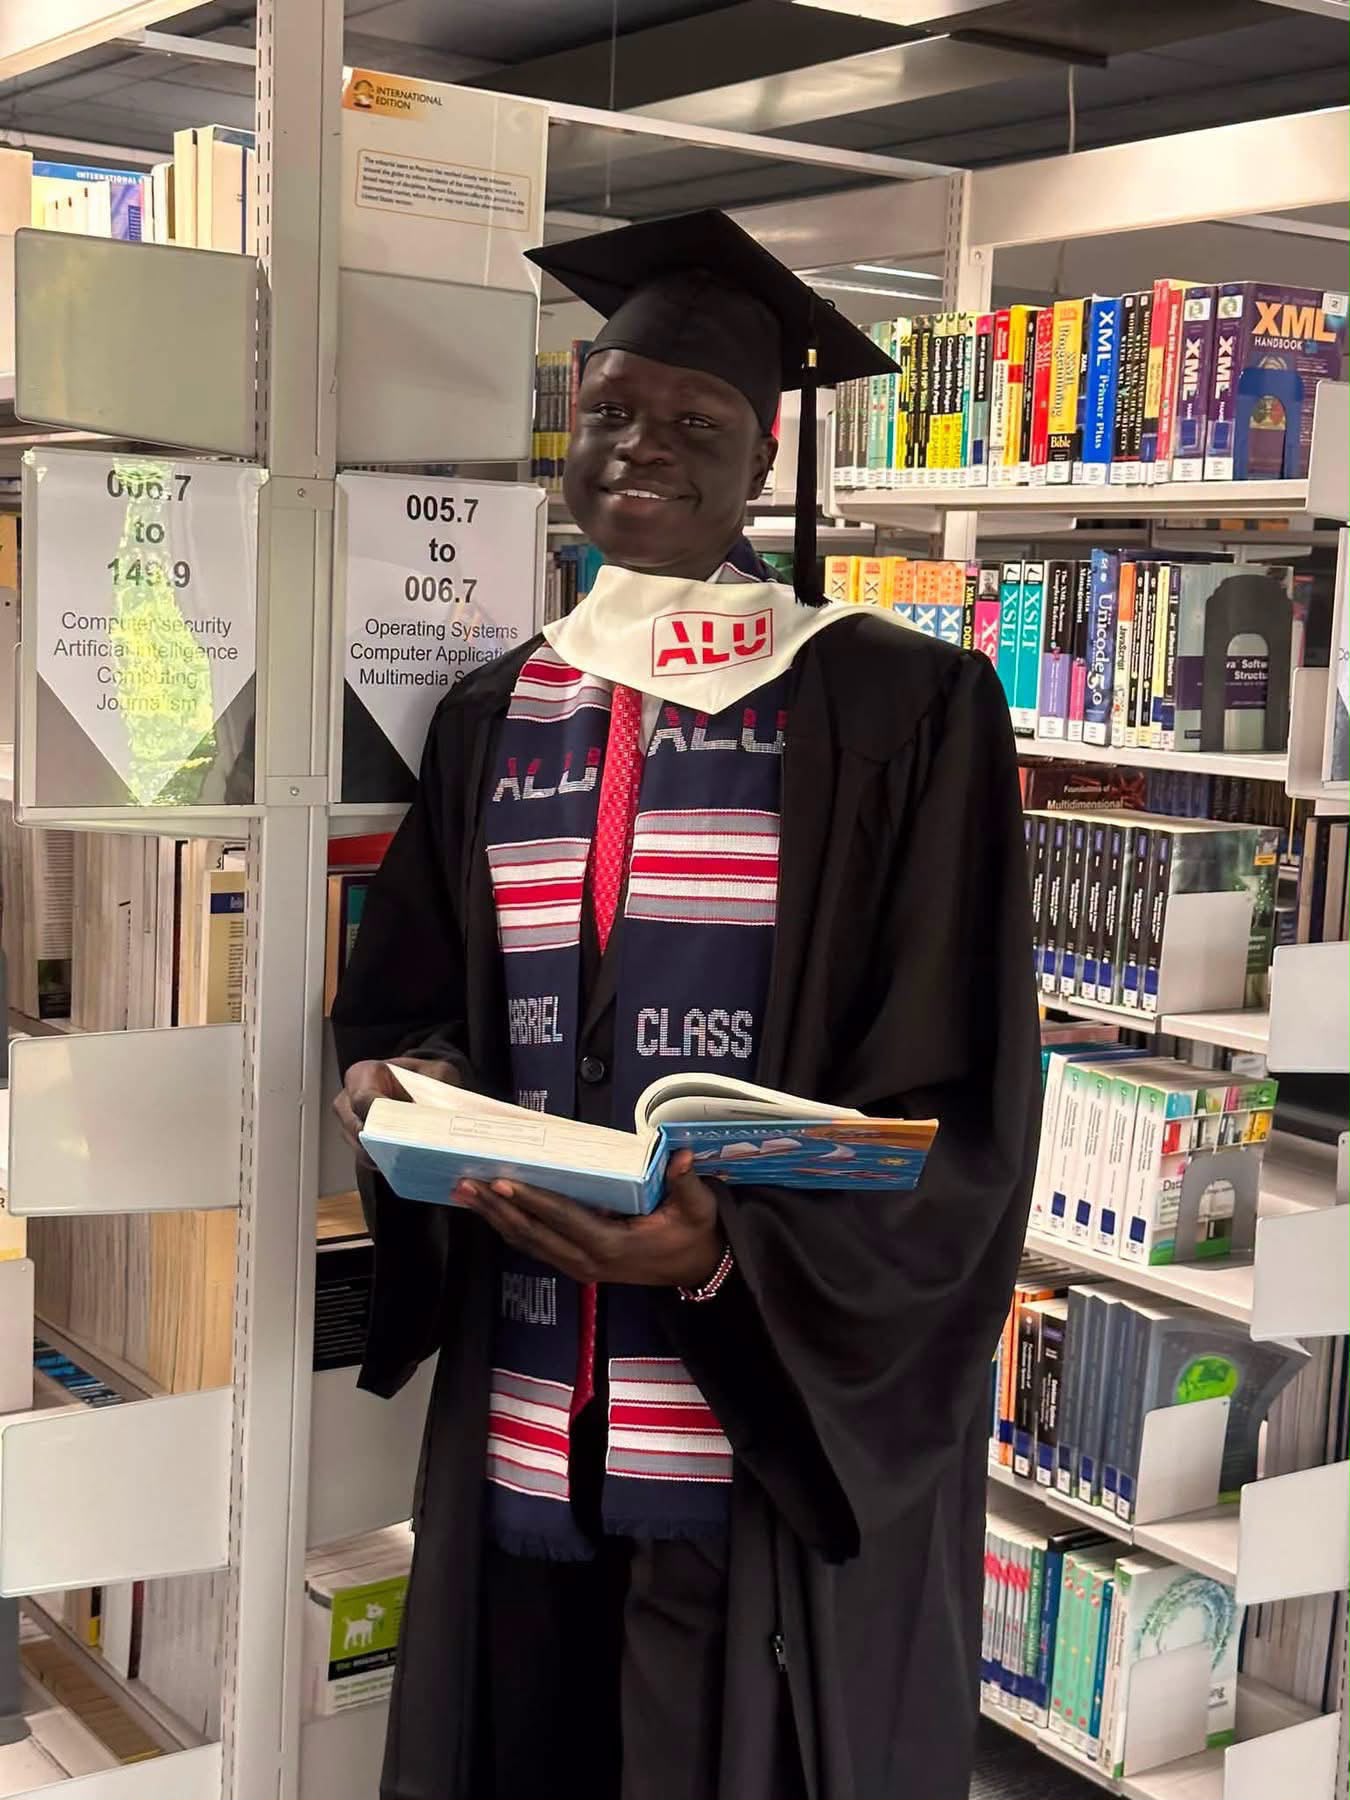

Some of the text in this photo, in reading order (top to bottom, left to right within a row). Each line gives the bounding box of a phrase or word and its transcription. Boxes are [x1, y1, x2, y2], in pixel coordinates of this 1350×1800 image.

[375, 86, 443, 106] INTERNATIONAL
[375, 95, 411, 110] EDITION
[1127, 312, 1135, 361] MODELING
[1251, 300, 1337, 343] XML
[933, 338, 942, 371] Creating
[945, 337, 954, 371] Creating
[1254, 337, 1303, 351] HANDBOOK
[1095, 310, 1115, 449] XML Primer Plus
[1135, 310, 1150, 450] MODELING BUSINESS OBJECTS
[1183, 338, 1202, 401] XML
[1215, 335, 1234, 400] XML
[1050, 435, 1071, 448] Bible
[1120, 411, 1129, 451] OBJECTS
[406, 494, 479, 523] 005.7
[133, 521, 165, 543] to
[429, 537, 456, 562] to
[405, 576, 478, 603] 006.7
[1060, 571, 1068, 583] The
[966, 586, 975, 608] XML
[1059, 585, 1067, 601] XML
[1076, 568, 1087, 624] Management
[61, 611, 232, 638] Computer security
[365, 618, 519, 639] Operating Systems
[1000, 590, 1020, 653] XSLT
[1020, 590, 1041, 654] XSLT
[53, 638, 130, 658] Artificial
[656, 616, 767, 668] ALU
[963, 625, 973, 650] DOM
[981, 617, 999, 665] XS
[1117, 625, 1128, 671] JavaScript
[350, 643, 506, 664] Computer Applicati
[97, 666, 199, 689] Computing
[359, 668, 469, 686] Multimedia S
[1087, 671, 1106, 706] 5.0
[647, 706, 788, 758] ALU
[492, 746, 599, 802] ALU
[1047, 799, 1124, 810] Multidimensional
[635, 1008, 754, 1059] CLASS
